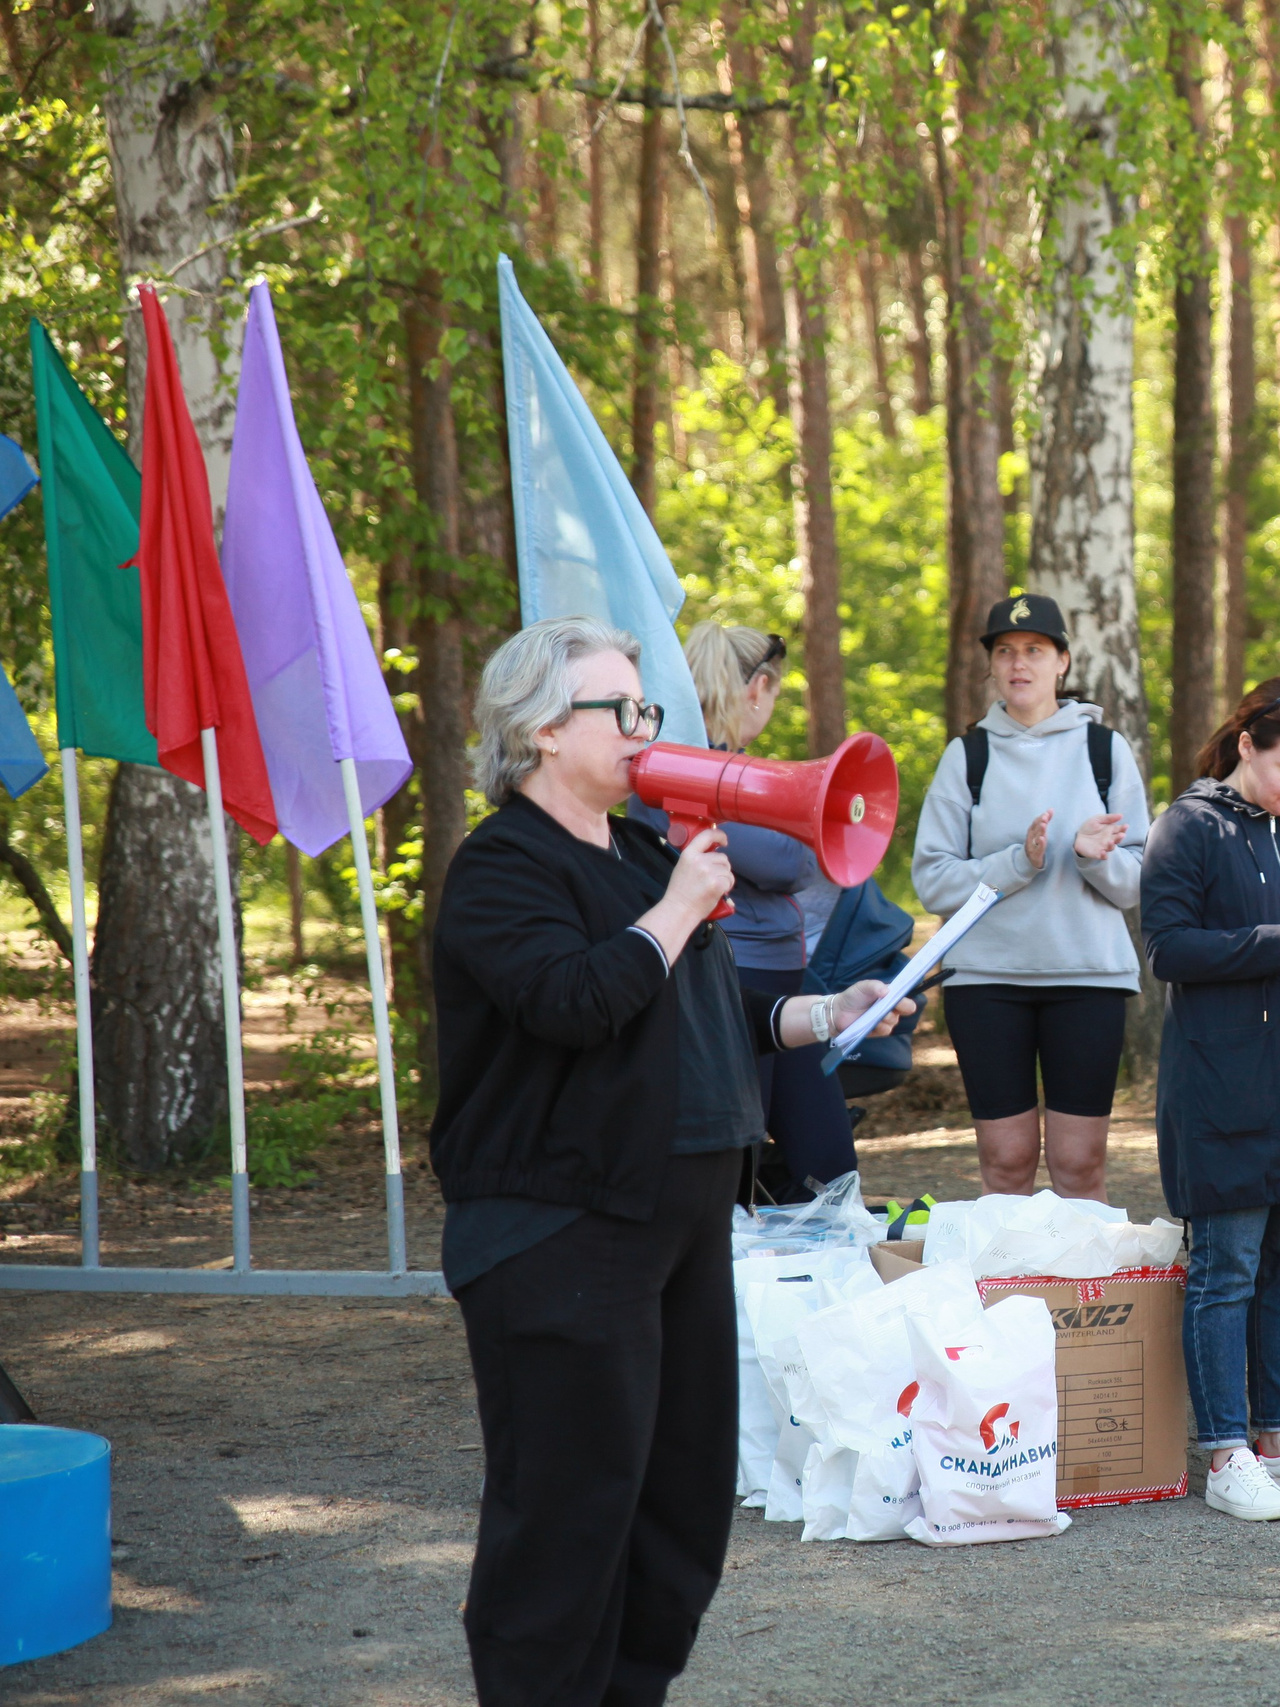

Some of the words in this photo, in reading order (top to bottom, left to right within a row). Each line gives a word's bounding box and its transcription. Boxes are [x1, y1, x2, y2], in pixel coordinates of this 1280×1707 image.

[1056, 1328, 1115, 1340] SWITZERLAND
[940, 1440, 1057, 1478] СКАНДИНАВИЯ
[948, 1523, 961, 1532] 908
